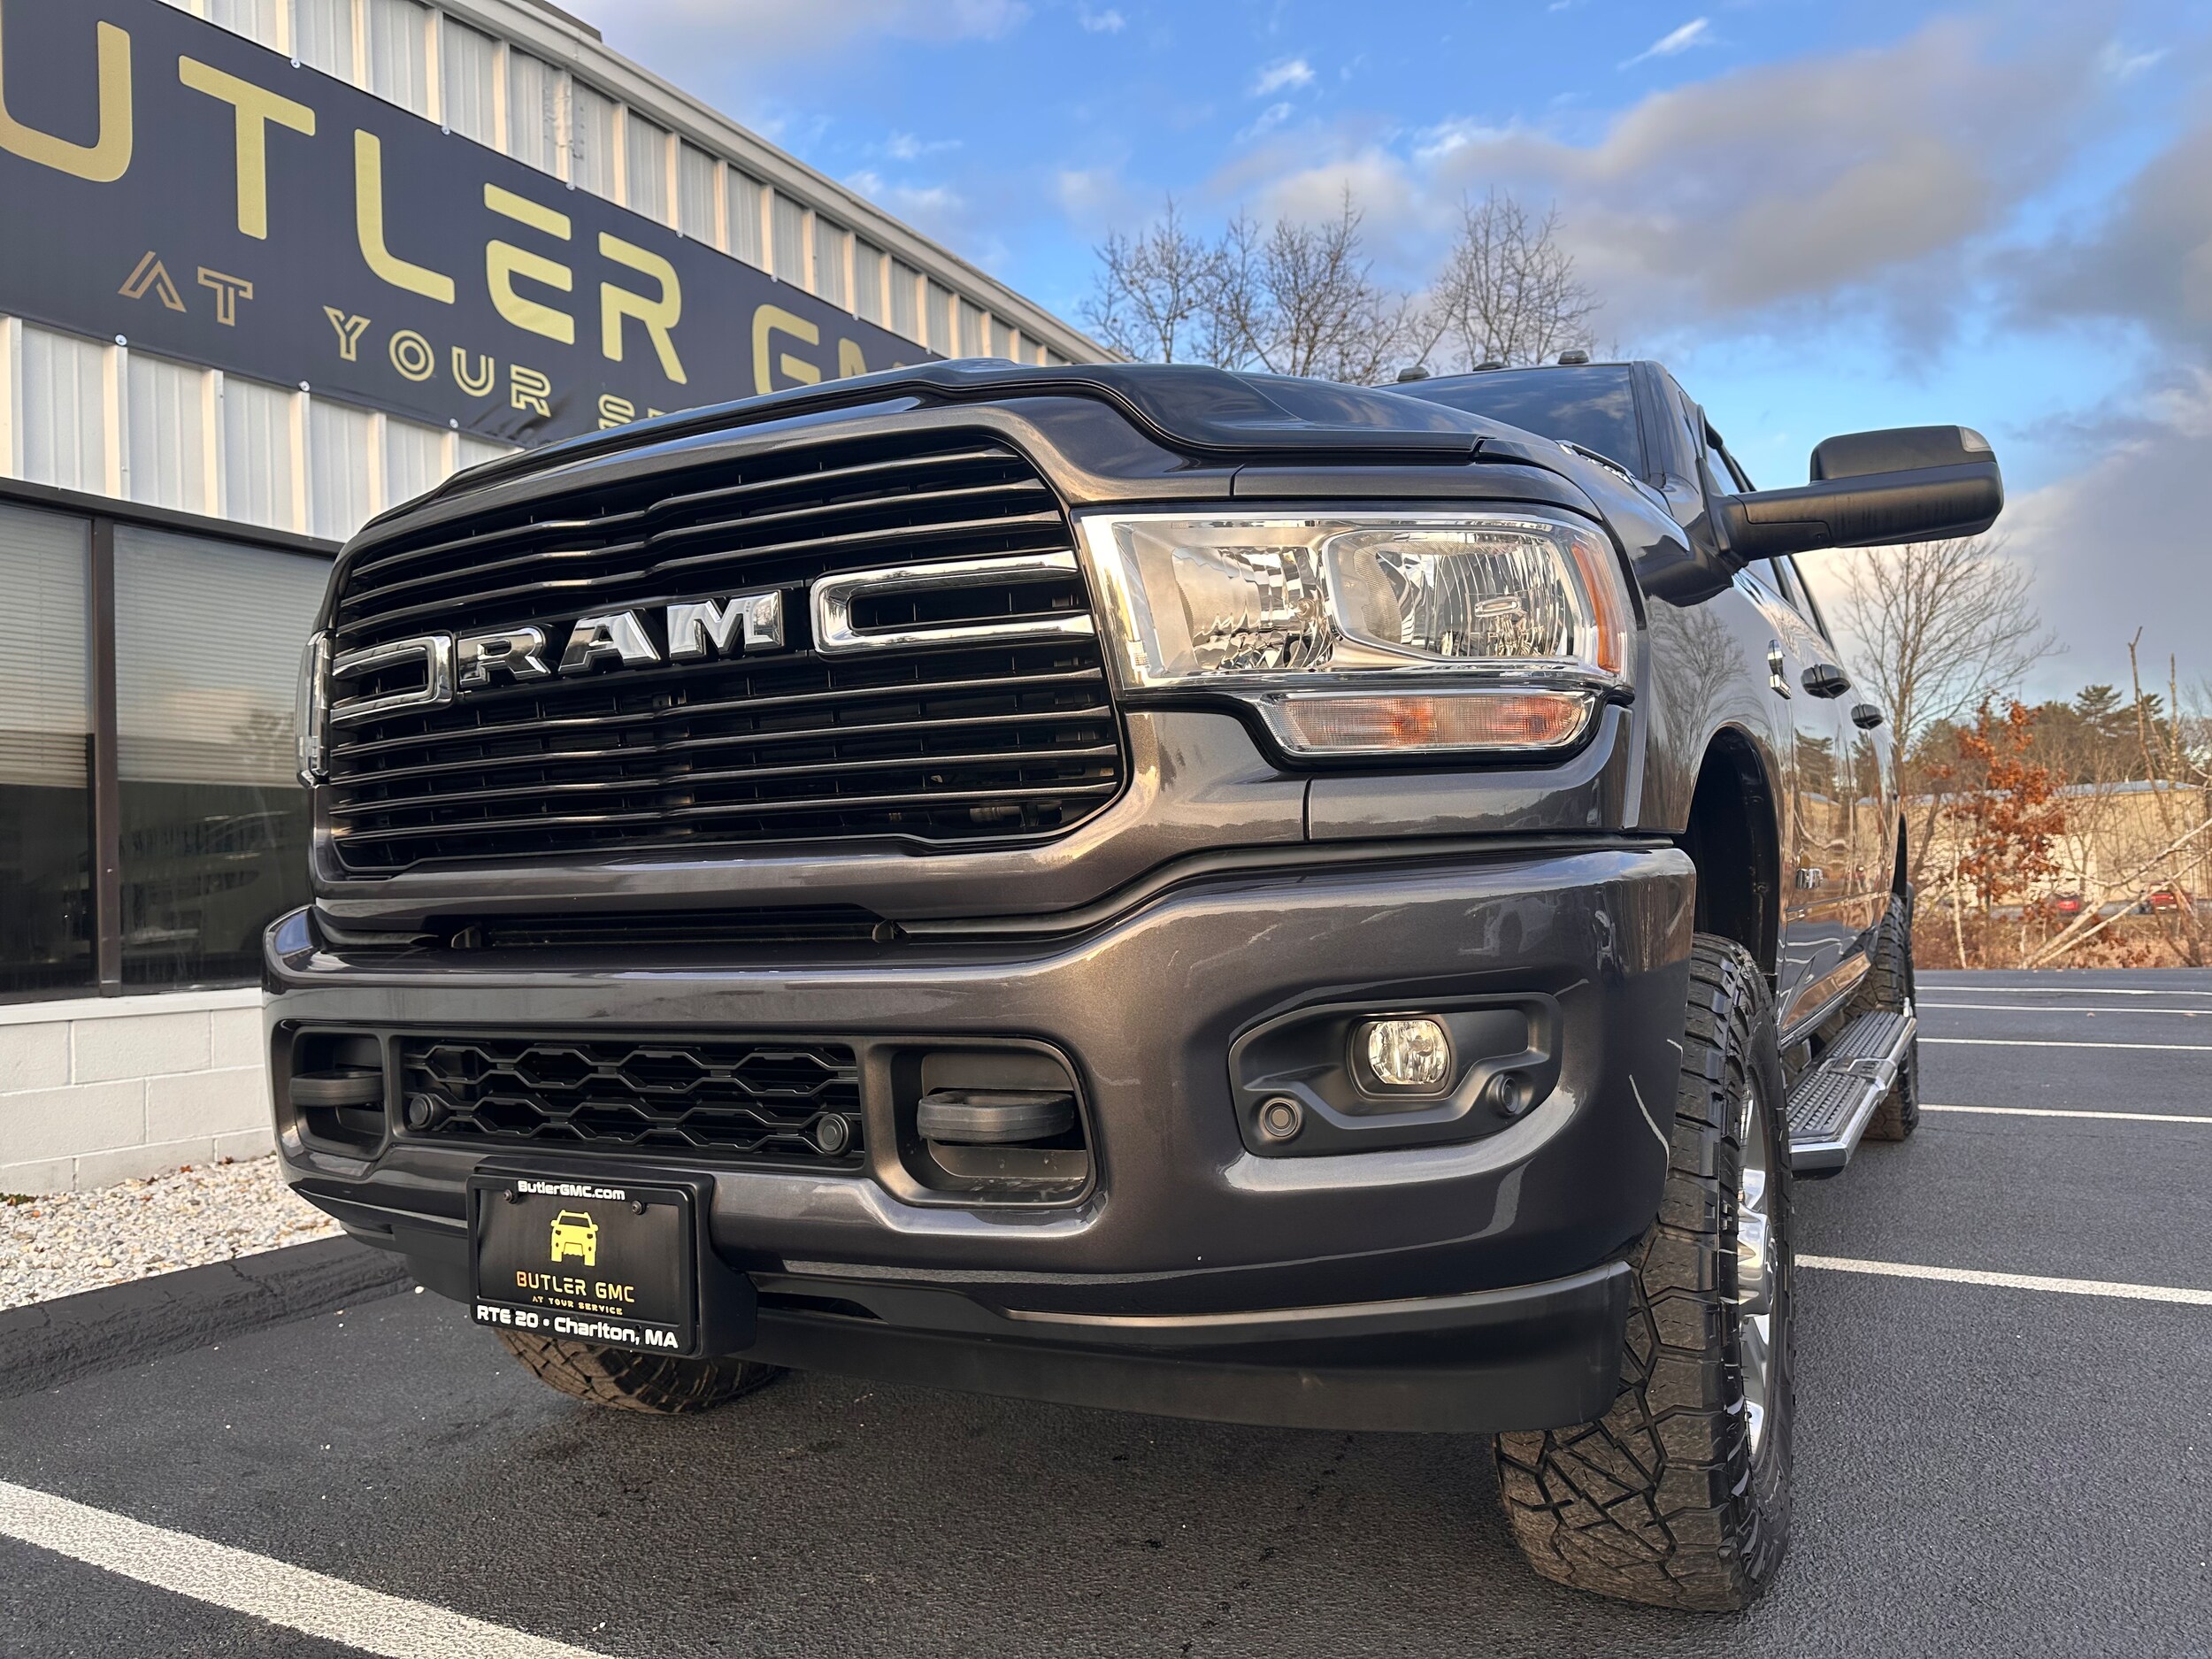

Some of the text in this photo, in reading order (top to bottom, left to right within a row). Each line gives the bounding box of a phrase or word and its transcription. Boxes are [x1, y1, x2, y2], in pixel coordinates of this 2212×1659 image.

[118, 250, 551, 418] AT YOUR
[458, 590, 786, 686] RAM
[518, 1180, 626, 1201] ButlerGMC.com
[516, 1271, 635, 1303] BUTLER GMC
[549, 1297, 574, 1309] YOUR
[579, 1302, 624, 1316] SERVICE
[477, 1305, 511, 1325] RTE
[515, 1310, 539, 1328] 20
[645, 1329, 679, 1348] MA
